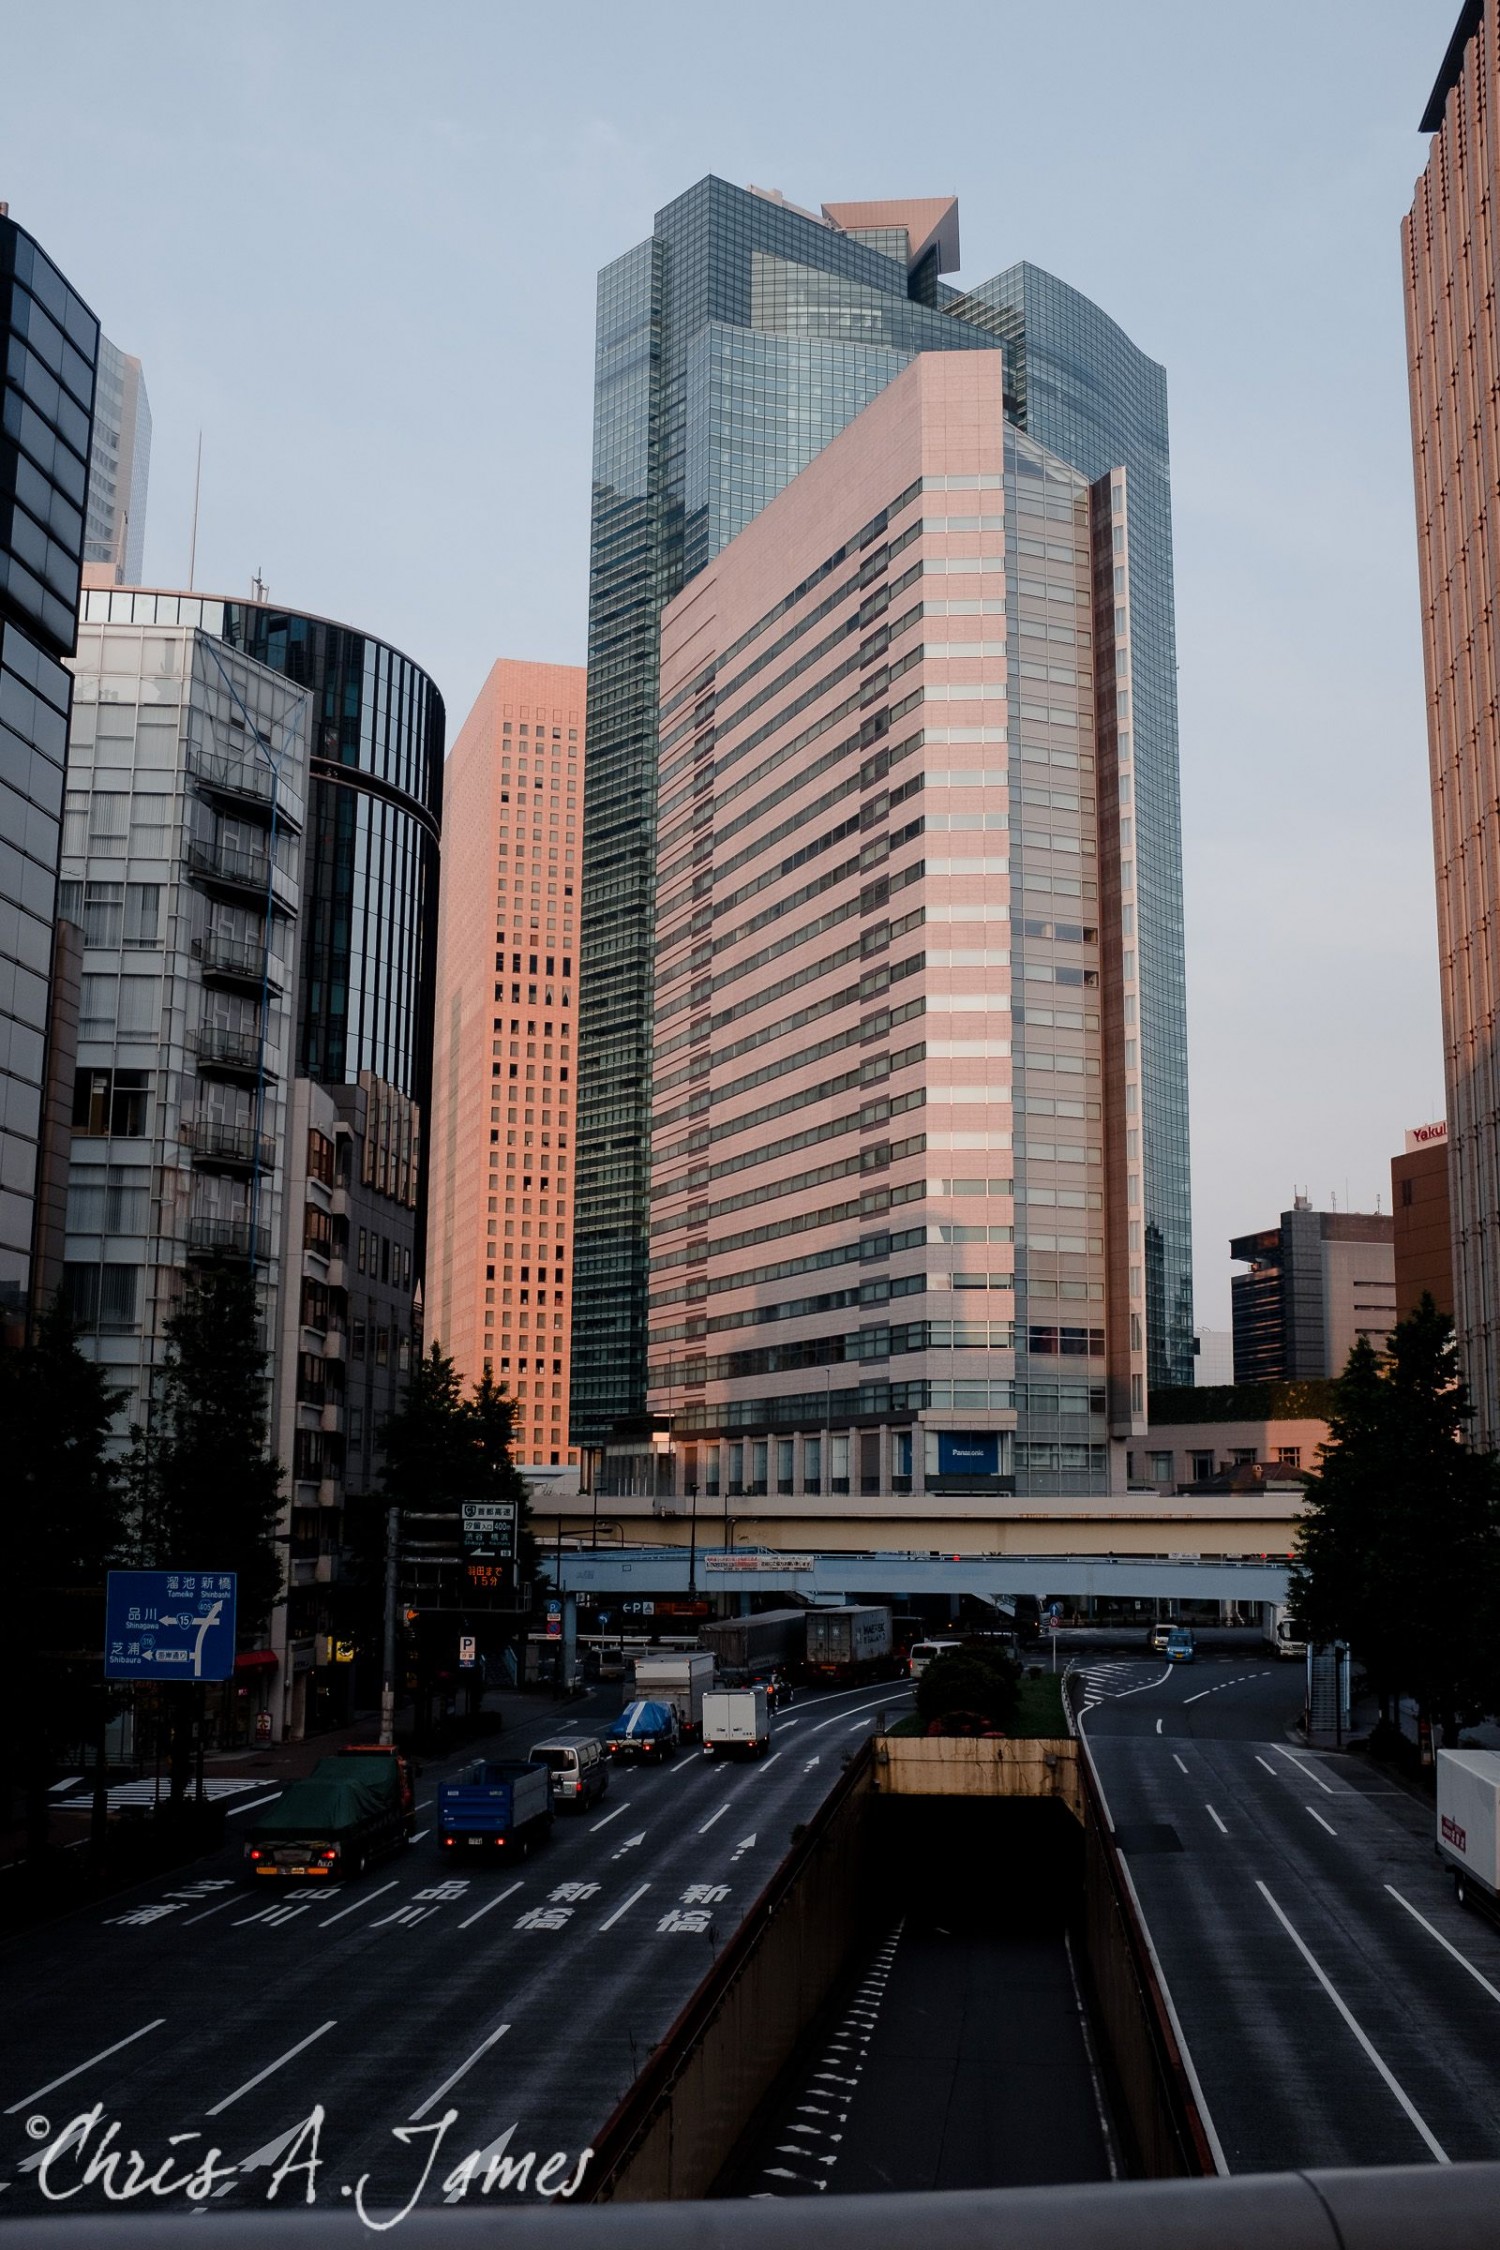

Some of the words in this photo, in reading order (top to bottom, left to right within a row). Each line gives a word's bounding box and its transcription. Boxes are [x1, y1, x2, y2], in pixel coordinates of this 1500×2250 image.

[1413, 1122, 1447, 1142] Yakul
[952, 1448, 985, 1456] Panasonic
[166, 1576, 196, 1590] 溜池
[200, 1576, 231, 1590] 新橋
[167, 1590, 194, 1598] Tameike
[200, 1590, 231, 1598] Shinbashi
[632, 1603, 642, 1613] P
[128, 1607, 157, 1620] 品川
[179, 1615, 190, 1625] 15
[125, 1621, 159, 1630] Shinagawa
[110, 1642, 140, 1656] 芝浦
[463, 1638, 473, 1650] P
[109, 1655, 141, 1664] Shibaura
